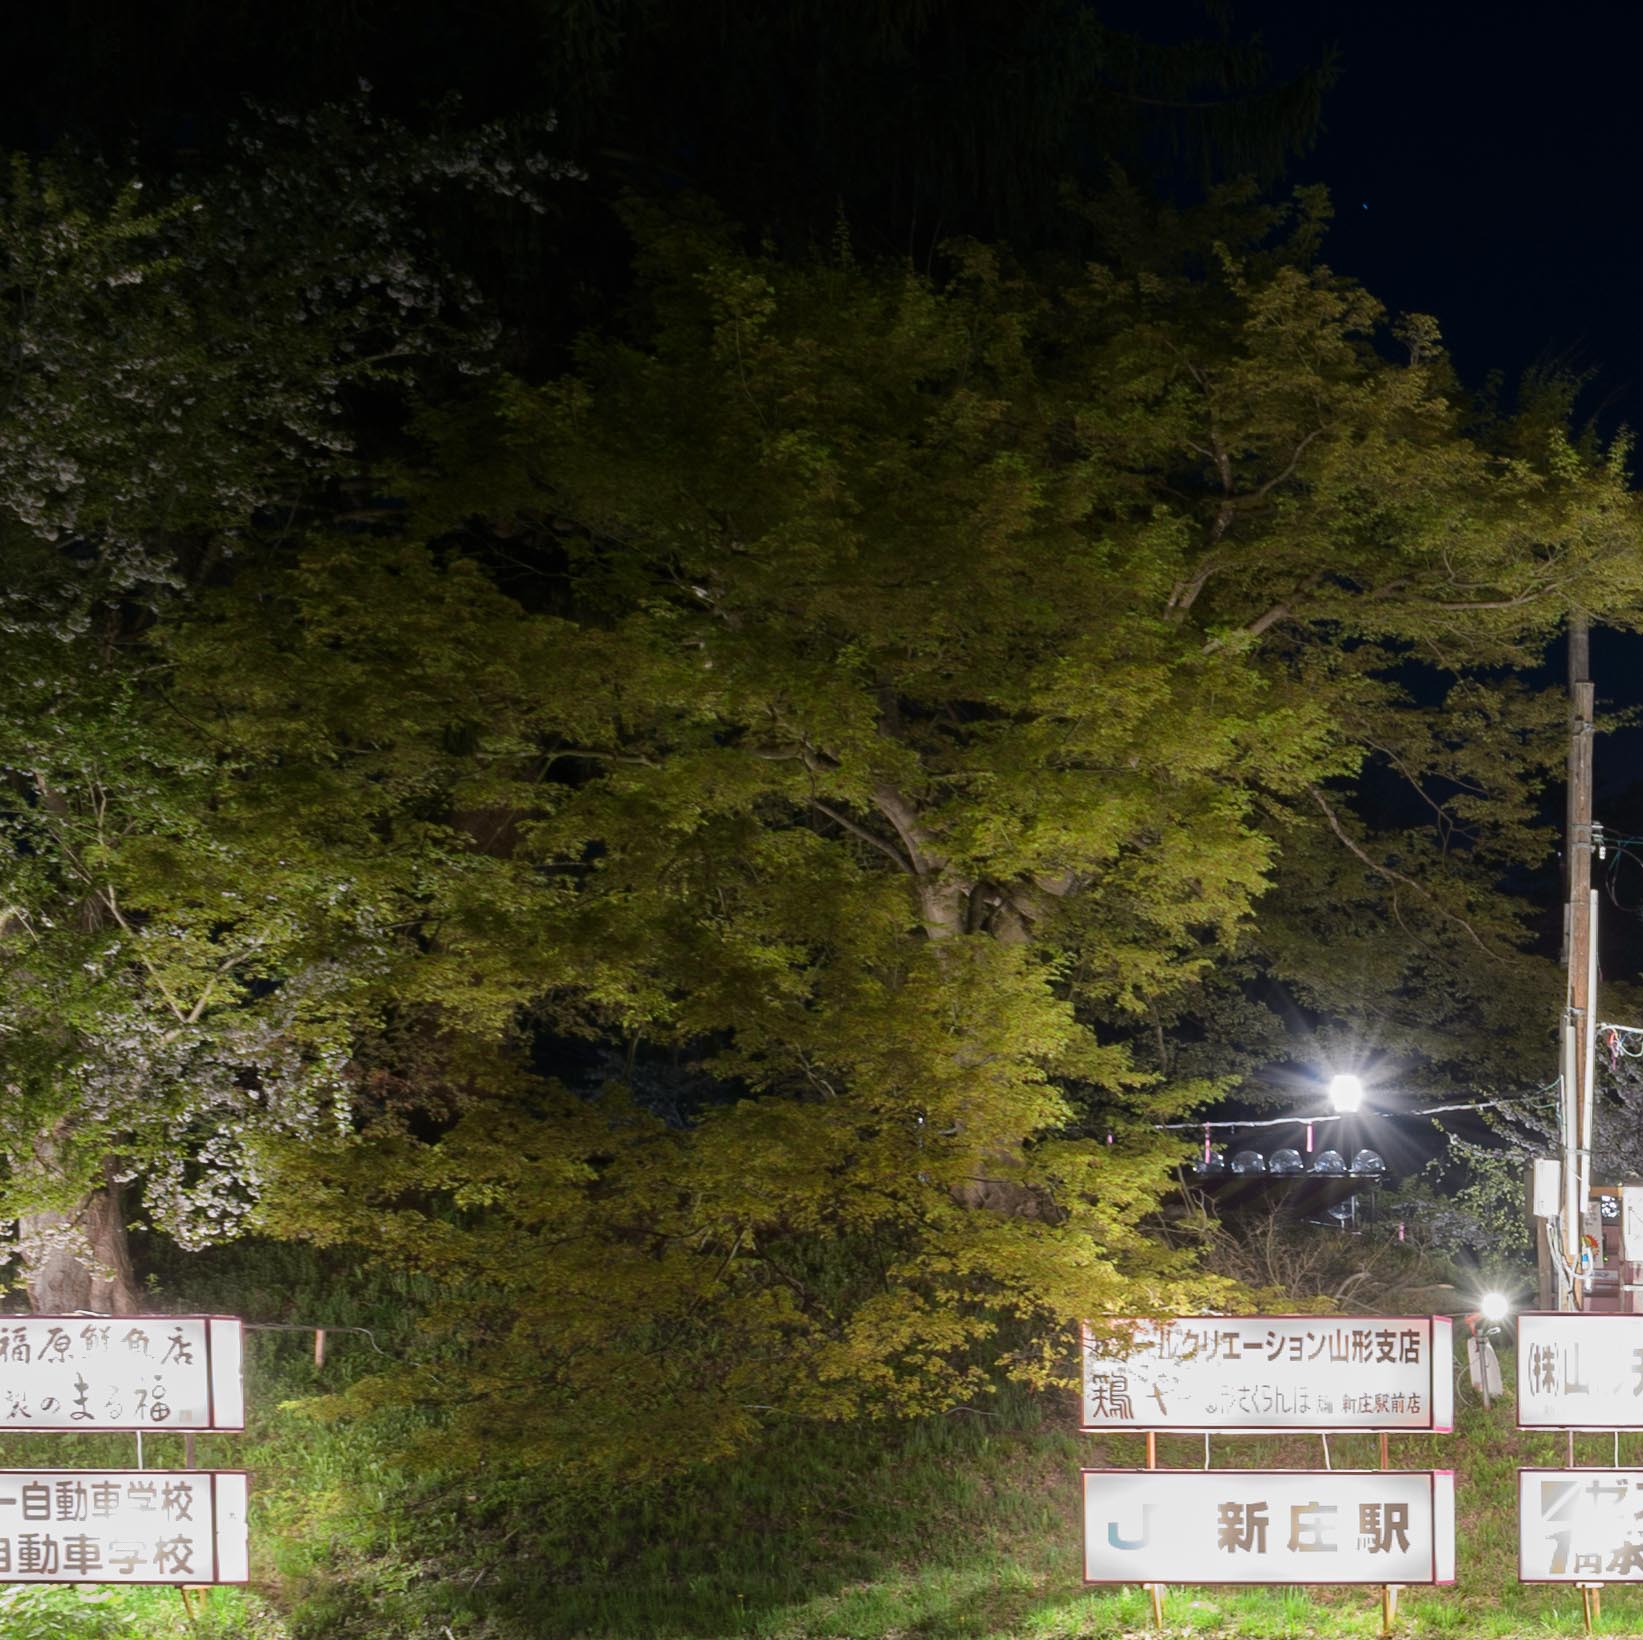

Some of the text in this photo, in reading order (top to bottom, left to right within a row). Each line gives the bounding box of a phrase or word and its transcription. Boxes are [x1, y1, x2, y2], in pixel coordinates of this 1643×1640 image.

[1341, 1391, 1422, 1416] 新庄駅前店
[1216, 1500, 1411, 1554] 新庄駅
